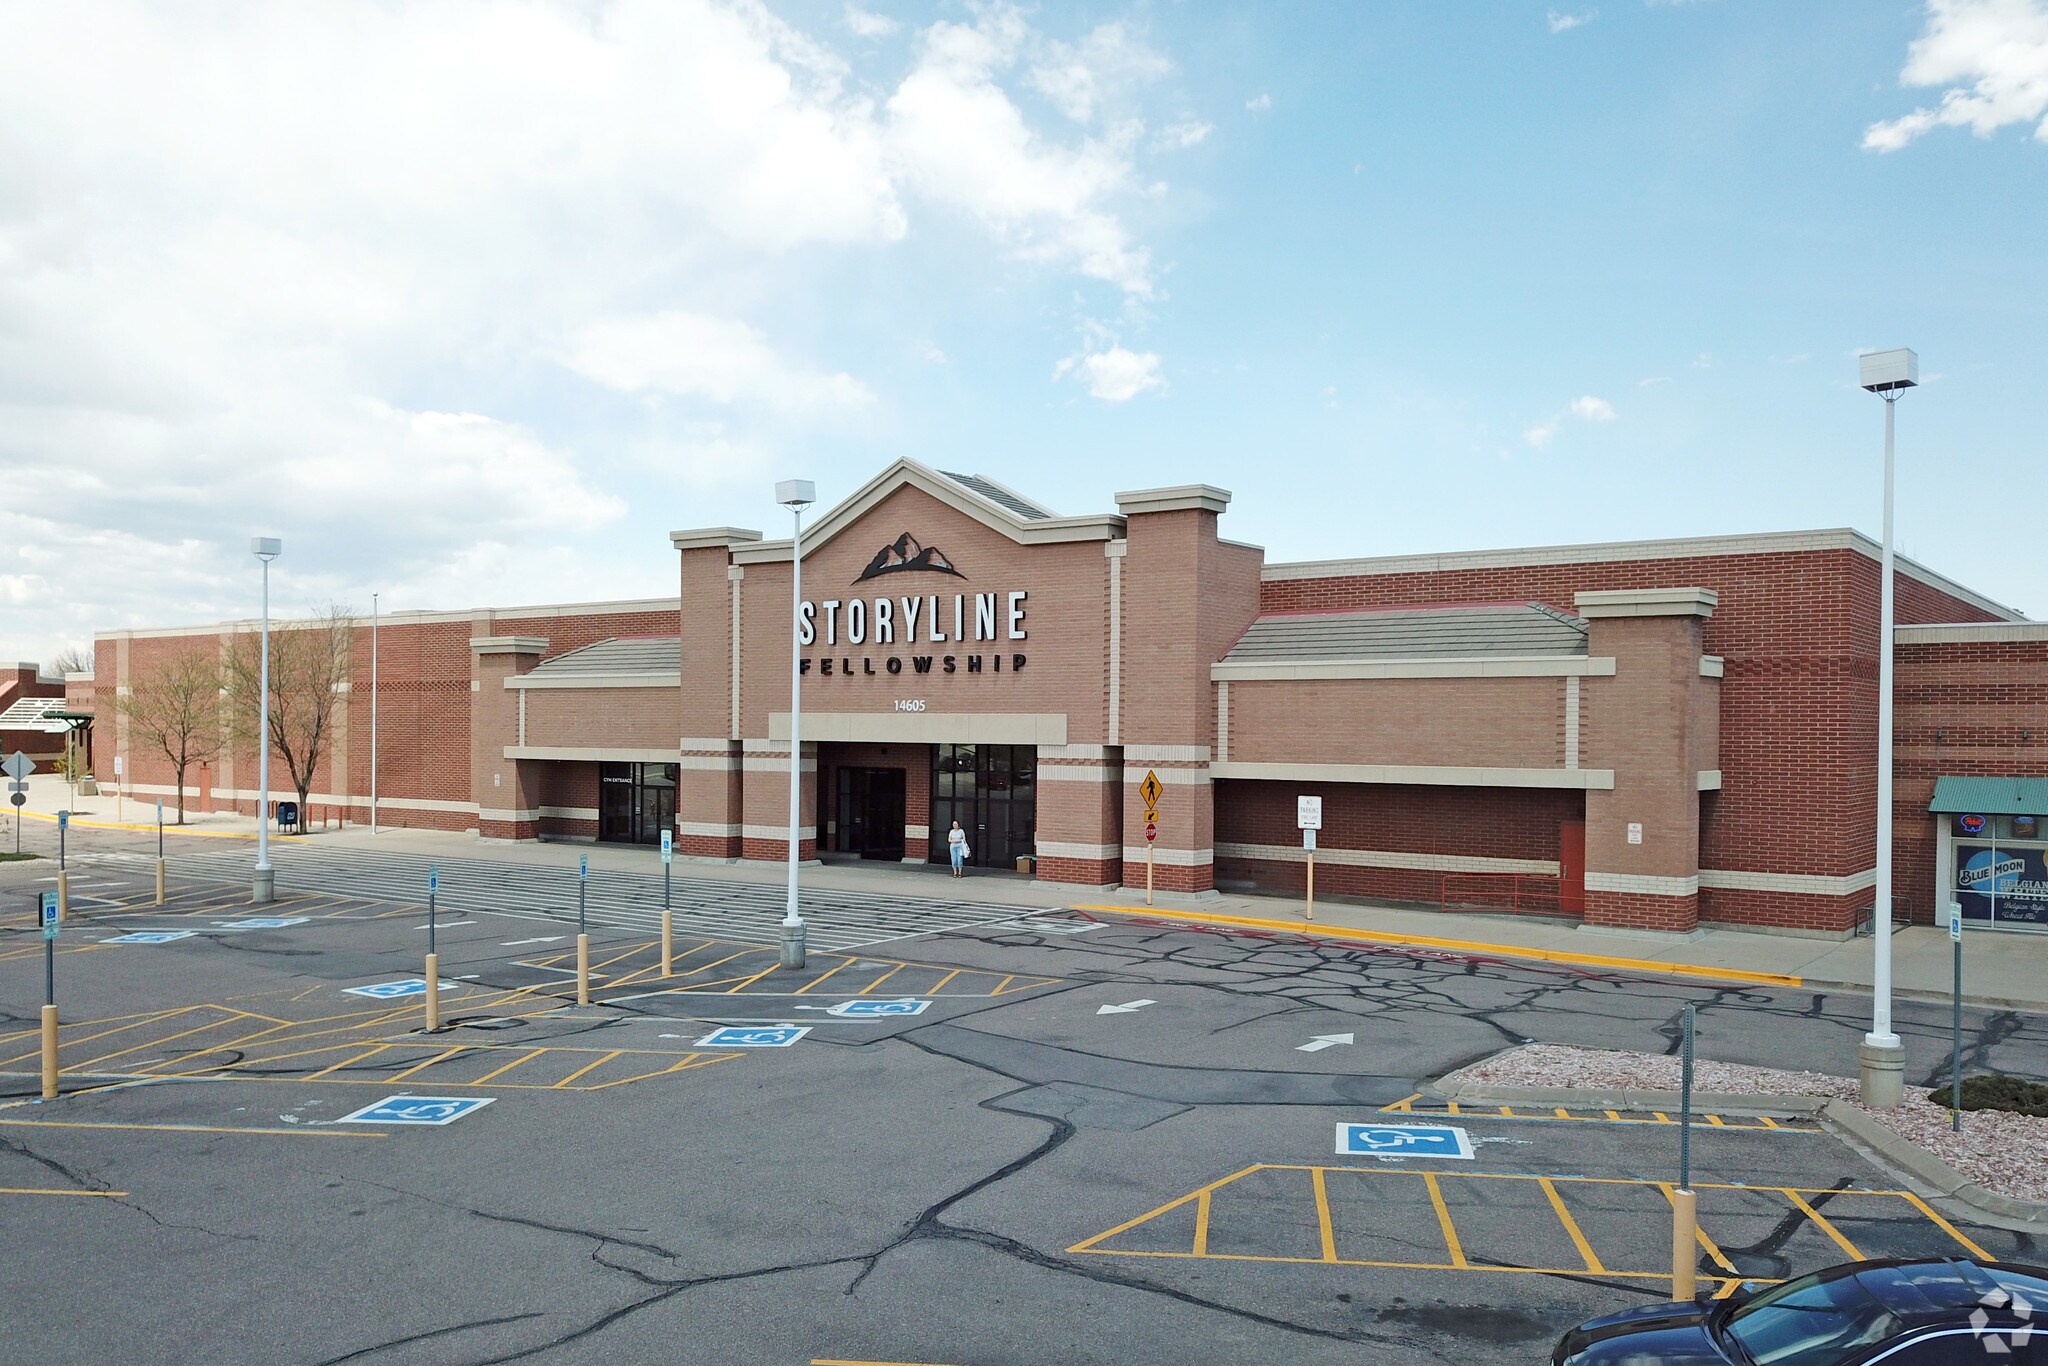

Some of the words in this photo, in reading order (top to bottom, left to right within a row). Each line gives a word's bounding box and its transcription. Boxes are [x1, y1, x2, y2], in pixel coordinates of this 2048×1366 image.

[799, 591, 1028, 645] STORYLINE
[799, 653, 1027, 676] FELLOWSHIP
[893, 699, 926, 712] 14605
[1961, 868, 1990, 884] BLUE
[1994, 861, 2023, 876] MOON
[2000, 879, 2048, 889] BELGIAN
